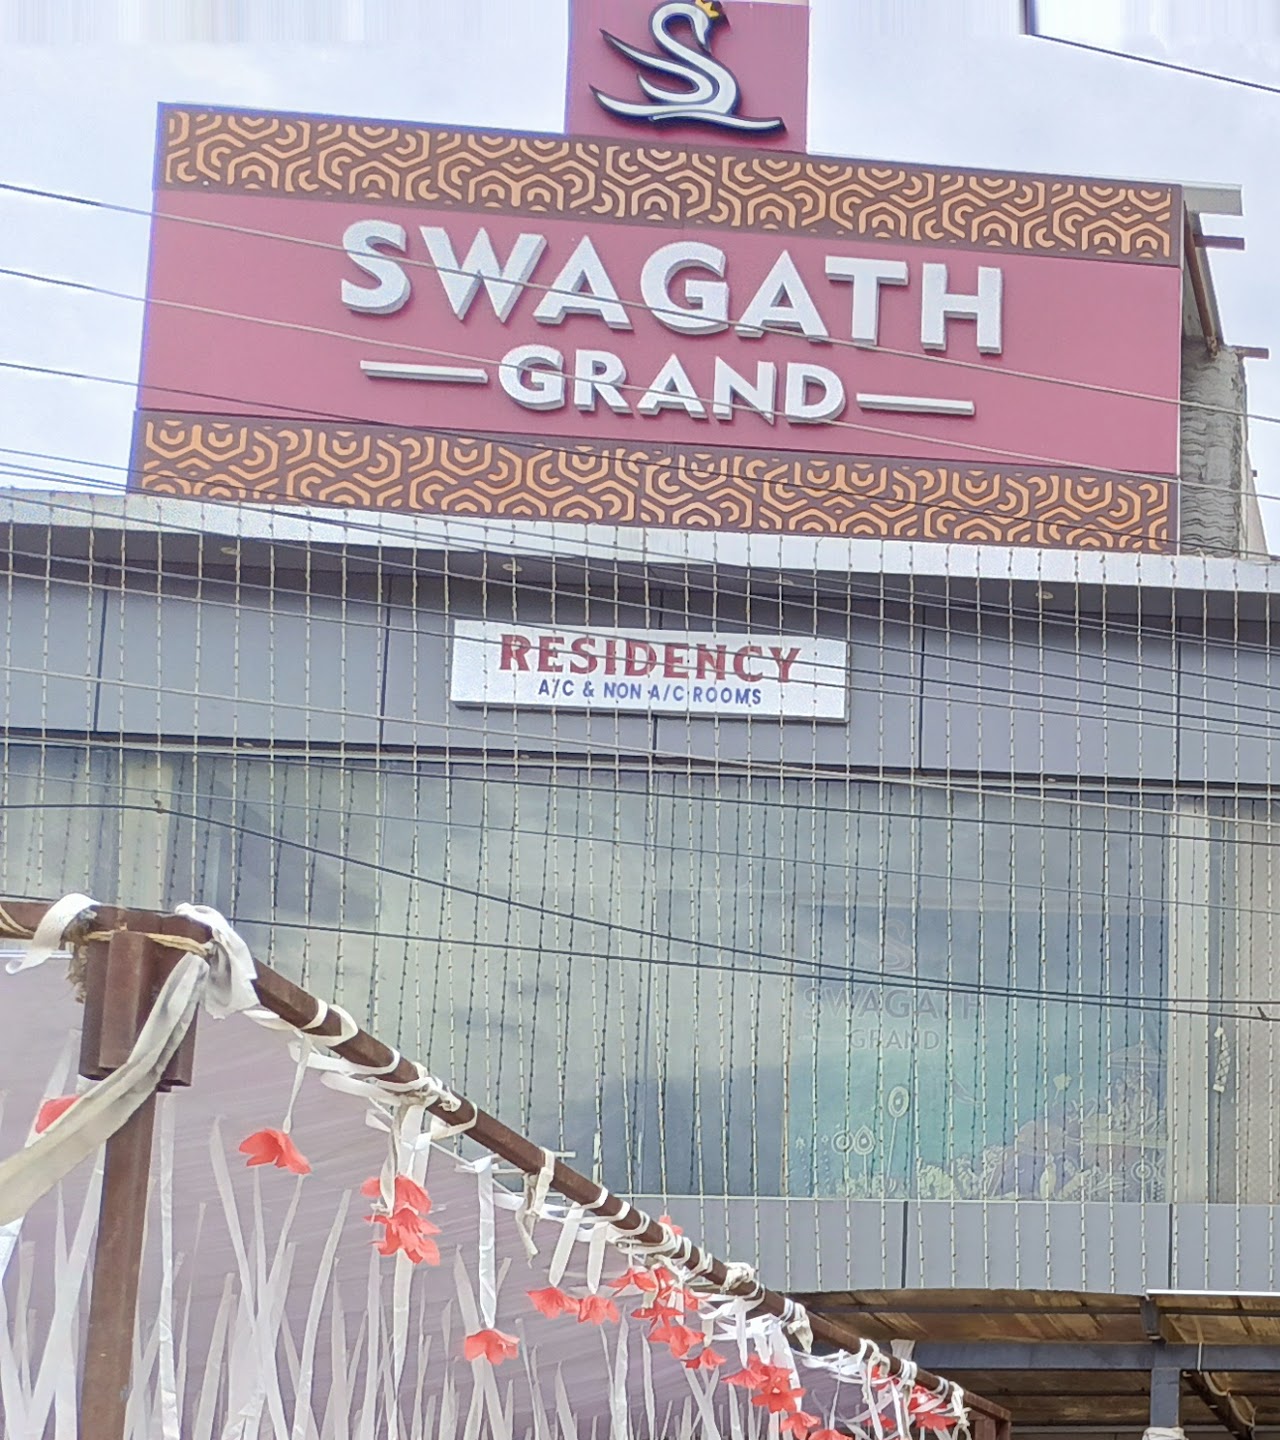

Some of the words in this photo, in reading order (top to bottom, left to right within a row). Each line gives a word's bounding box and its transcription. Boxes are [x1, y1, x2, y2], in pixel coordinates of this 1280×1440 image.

[341, 219, 1003, 354] SWAGATH
[498, 344, 846, 425] GRAND
[500, 633, 801, 682] RESIDENCY
[538, 679, 574, 698] A/C
[582, 680, 594, 697] &
[603, 682, 641, 700] NON
[650, 684, 684, 702] A/C
[692, 686, 762, 706] ROOMS
